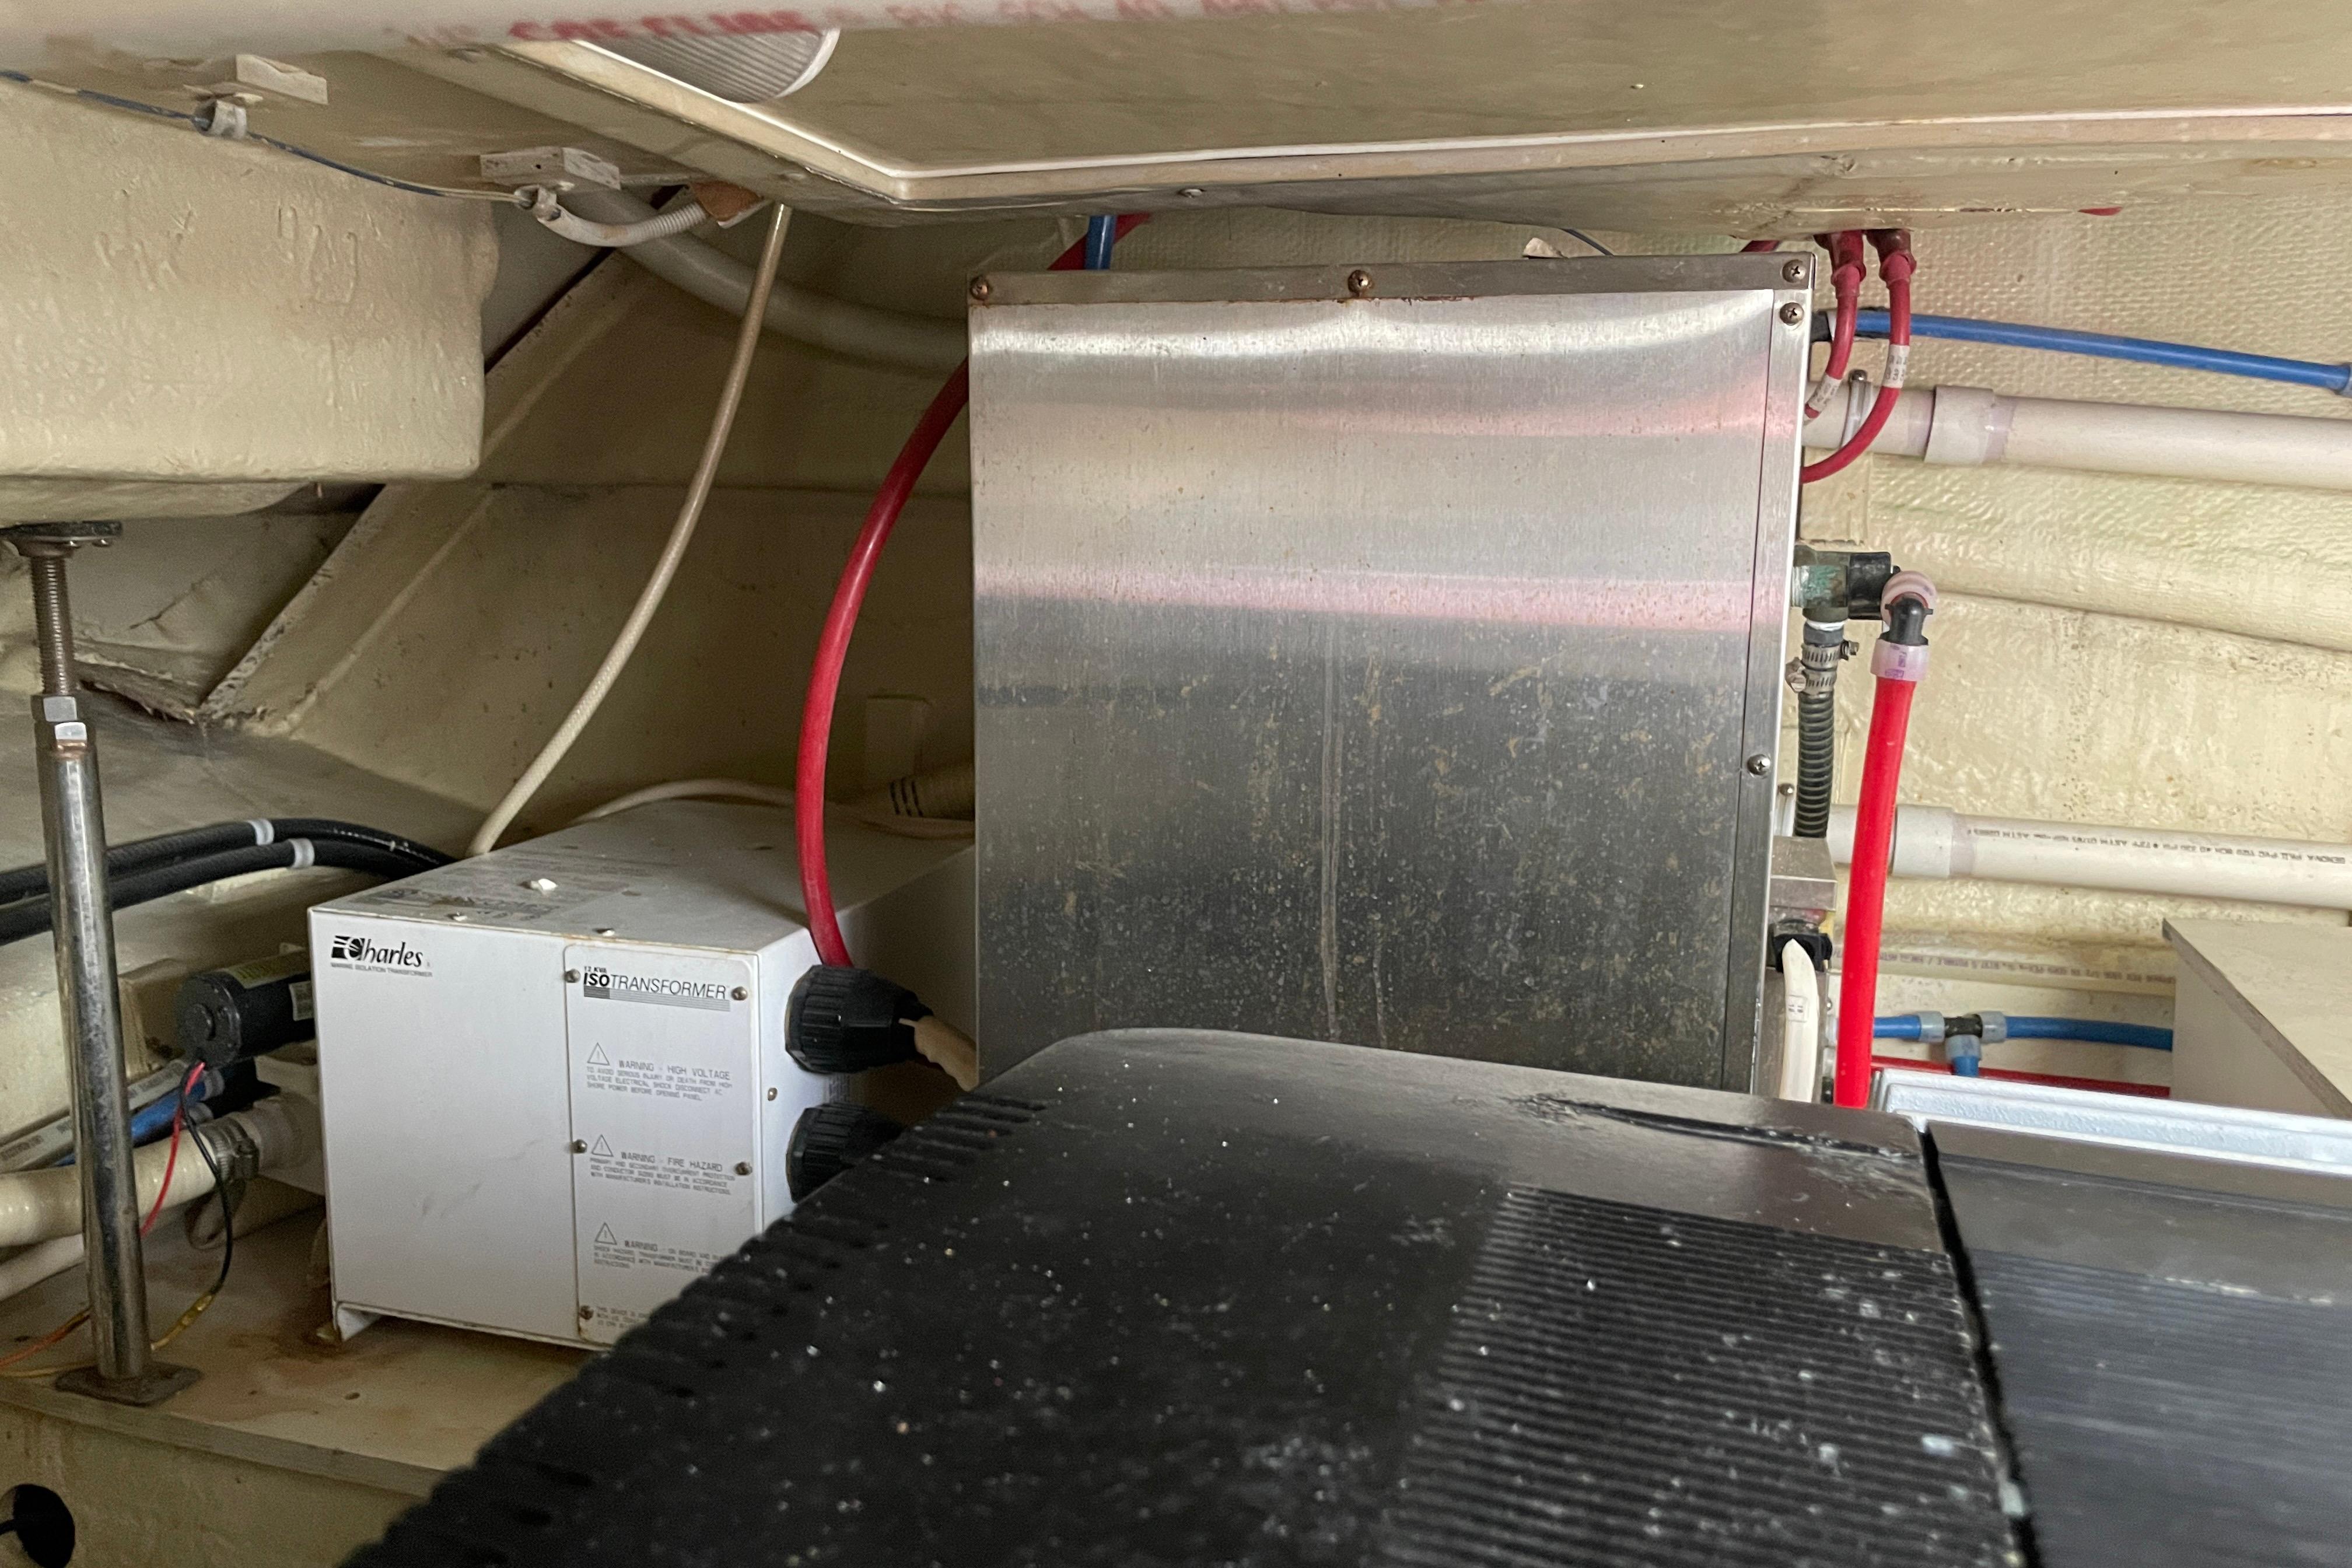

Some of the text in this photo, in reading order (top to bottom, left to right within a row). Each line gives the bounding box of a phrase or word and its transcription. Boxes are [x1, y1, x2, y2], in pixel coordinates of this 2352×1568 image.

[331, 935, 423, 967] Charles
[355, 964, 386, 972] ISOLATION
[387, 967, 433, 977] TRANSFORMER
[618, 1059, 654, 1071] WARNING
[668, 1065, 687, 1074] HIGH
[692, 1068, 731, 1080] VOLTAGE
[621, 1152, 655, 1163] WARNING
[668, 1157, 684, 1167] FIRE
[690, 1161, 722, 1172] HAZARD
